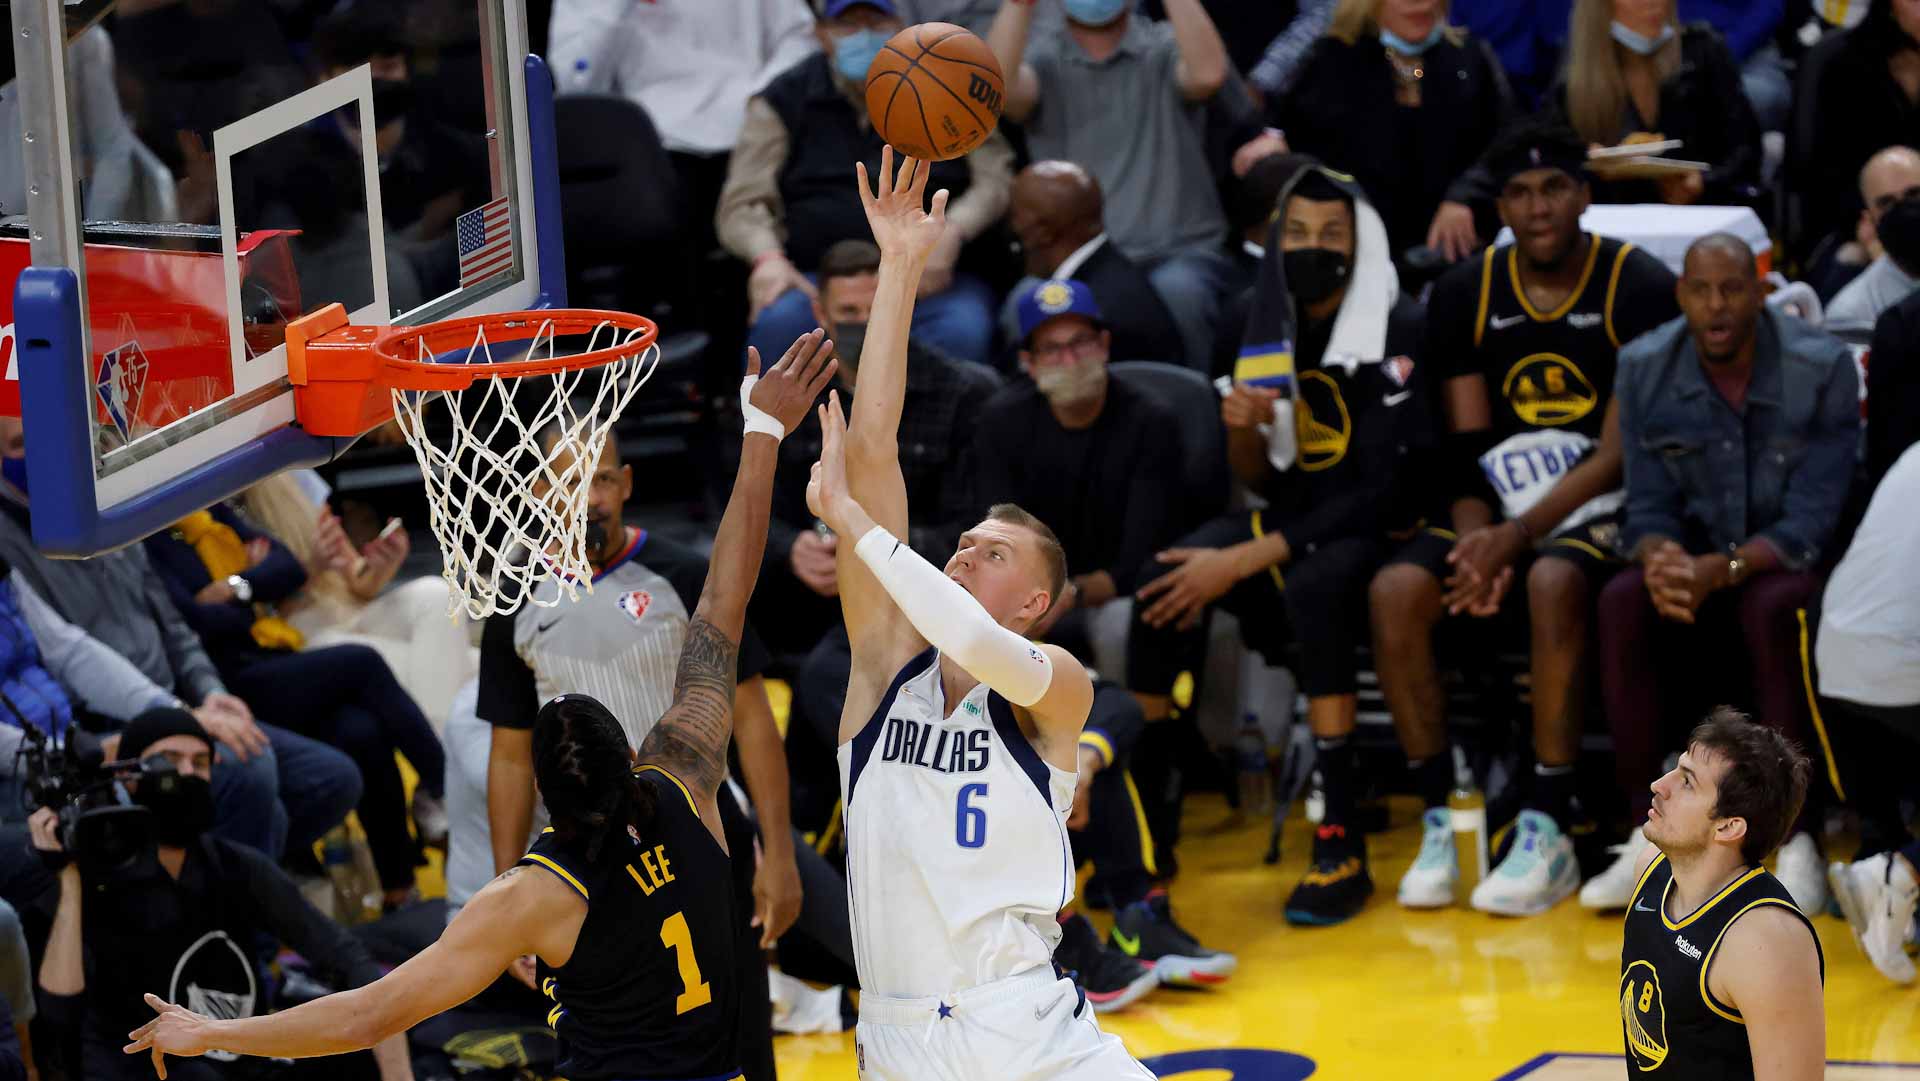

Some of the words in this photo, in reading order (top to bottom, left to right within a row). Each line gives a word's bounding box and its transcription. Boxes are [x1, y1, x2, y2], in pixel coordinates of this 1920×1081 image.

[881, 718, 990, 773] DALLAS
[956, 783, 989, 848] 6
[625, 844, 676, 896] LEE
[659, 911, 712, 1016] 1
[1675, 934, 1703, 961] Rakuten
[1638, 980, 1654, 1014] 8
